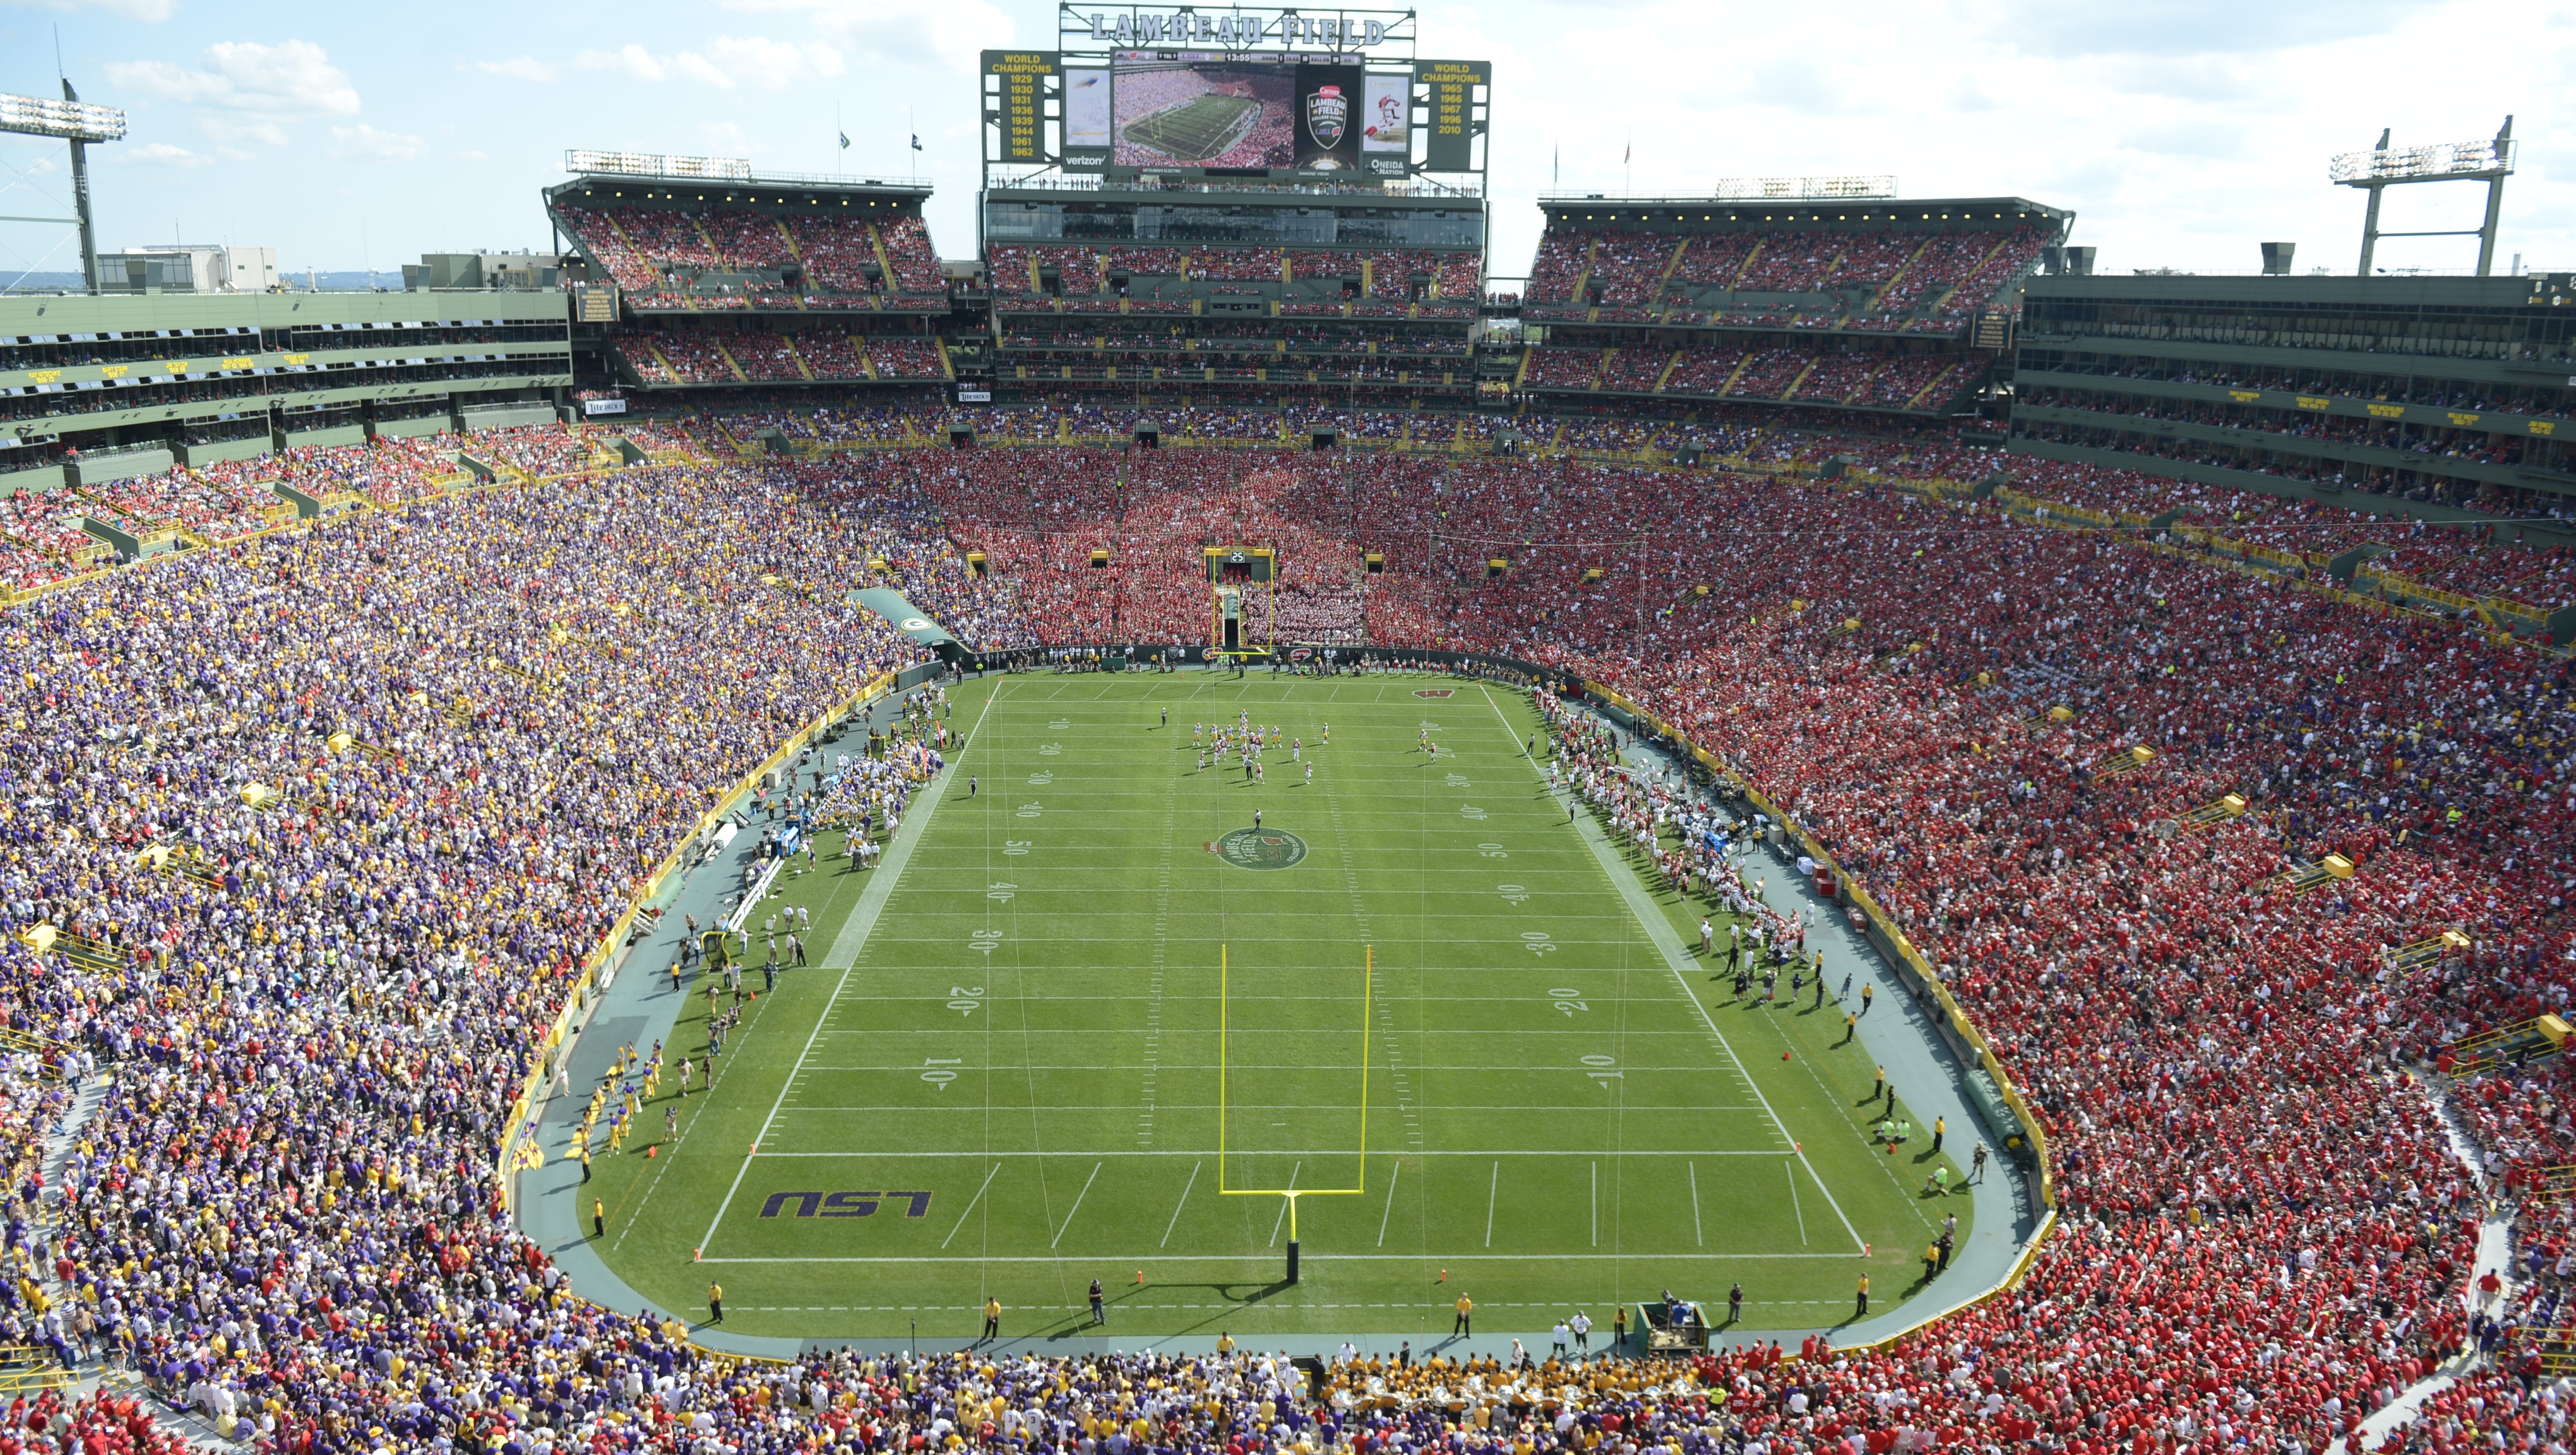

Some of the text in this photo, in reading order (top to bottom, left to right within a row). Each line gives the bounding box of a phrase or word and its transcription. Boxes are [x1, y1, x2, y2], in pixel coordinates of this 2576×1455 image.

[1091, 14, 1384, 46] LAMBEAU FIELD
[1005, 54, 1040, 63] WORLD
[992, 64, 1052, 74] CHAMPIONS
[1435, 64, 1470, 73] WORLD
[1011, 75, 1032, 83] 1929
[1422, 73, 1480, 83] CHAMPIONS
[1011, 85, 1033, 94] 1930
[1319, 87, 1340, 96] Carmex
[1440, 84, 1462, 93] 1965
[1011, 95, 1031, 104] 1931
[1310, 98, 1345, 110] LAMBEAU
[1440, 95, 1462, 103] 1966
[1011, 106, 1033, 115] 1936
[1318, 107, 1339, 115] FIELD
[1440, 105, 1461, 114] 1967
[1012, 116, 1033, 125] 1939
[1440, 115, 1462, 124] 1996
[1012, 127, 1033, 135] 1944
[1439, 126, 1461, 134] 2010
[1012, 137, 1031, 146] 1961
[1012, 147, 1033, 156] 1962
[1066, 155, 1102, 166] verizon
[1371, 159, 1404, 170] ONEIDA
[590, 404, 603, 413] Lite
[1232, 552, 1243, 561] 25
[1039, 745, 1062, 755] 20
[1028, 773, 1053, 784] 30
[1444, 776, 1471, 787] 30
[1016, 804, 1043, 817] 40
[1460, 808, 1488, 820] 40
[1003, 840, 1032, 855] 50
[1478, 843, 1508, 858] 50
[987, 882, 1018, 899] 40
[1498, 884, 1530, 902] 40
[968, 930, 1003, 950] 30
[1520, 932, 1556, 952] 30
[947, 987, 985, 1010] 20
[1548, 988, 1589, 1011] 20
[920, 1058, 962, 1082] 10
[1580, 1055, 1624, 1079] 10
[758, 1190, 933, 1219] LSU
[678, 1444, 684, 1453] 7
